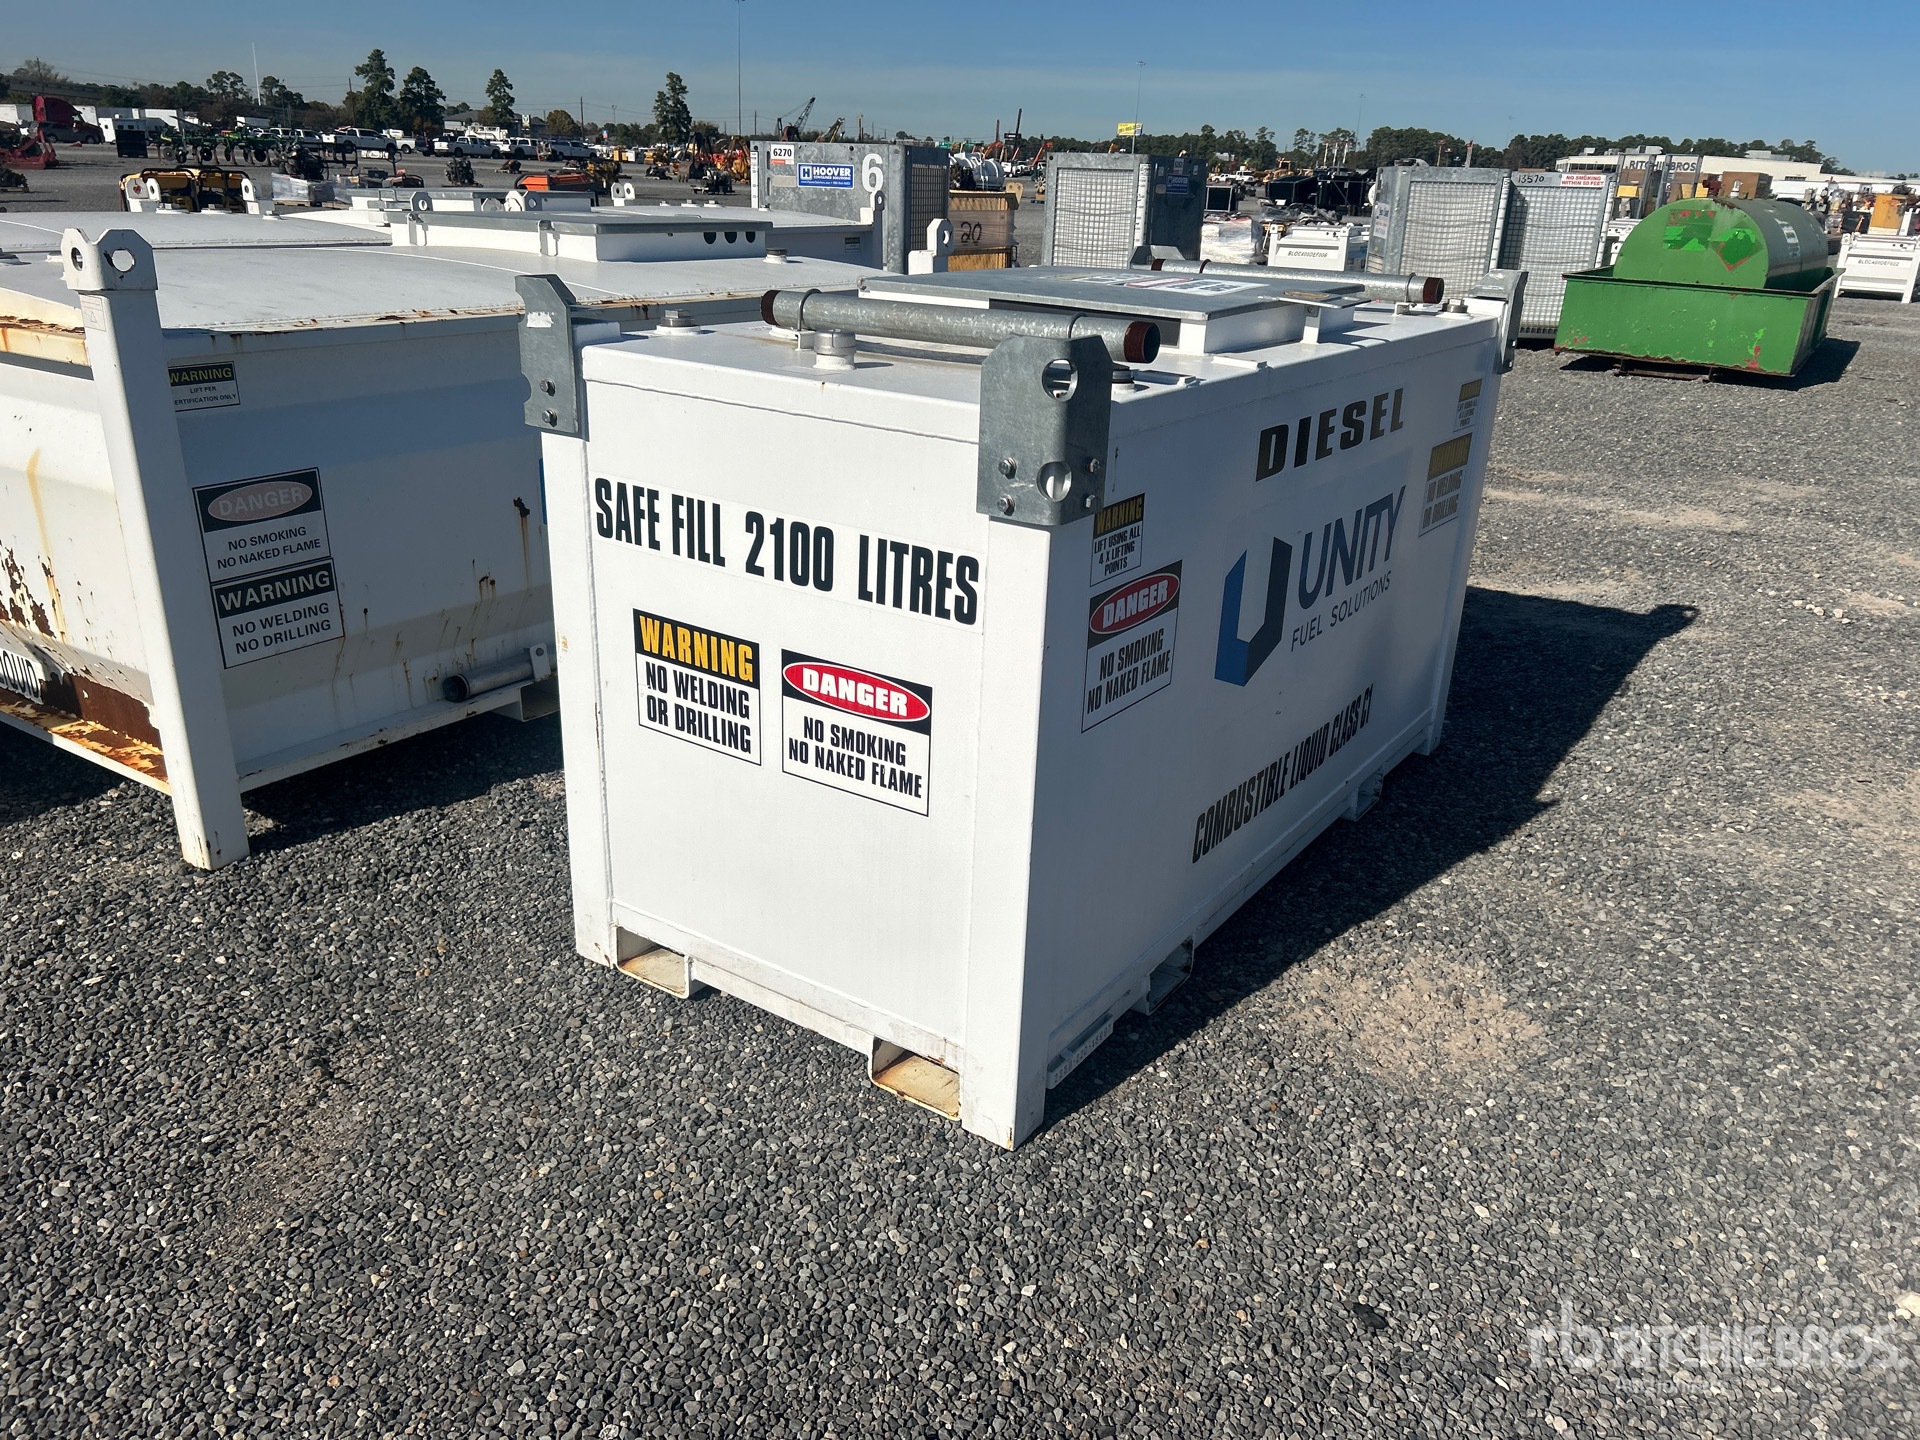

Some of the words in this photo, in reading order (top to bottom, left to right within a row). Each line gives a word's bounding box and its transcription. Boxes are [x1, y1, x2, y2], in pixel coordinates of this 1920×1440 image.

[773, 148, 792, 157] 6270
[812, 166, 851, 176] HOOVER
[862, 153, 884, 192] 6
[174, 396, 219, 406] ERTIFICATION
[219, 393, 237, 401] ONLY
[204, 385, 217, 393] PER
[1255, 387, 1404, 482] DIESEL
[218, 486, 304, 517] DANGER
[1096, 498, 1143, 534] WARNING
[217, 556, 237, 570] NO
[238, 549, 281, 566] NAKED
[282, 538, 321, 556] FLAME
[228, 538, 248, 551] NO
[249, 526, 307, 547] SMOKING
[595, 477, 661, 551] SAFE
[671, 493, 726, 567] FILL
[745, 511, 834, 592] 2100
[858, 534, 980, 626] LITRES
[1093, 540, 1107, 554] LIFT
[1108, 529, 1128, 548] USING
[1129, 524, 1141, 538] ALL
[1111, 540, 1136, 560] LIFTING
[1299, 484, 1406, 610] UNITY
[220, 570, 331, 612] WARNING
[1104, 560, 1128, 577] POINTS
[232, 621, 256, 637] NO
[259, 602, 330, 629] WELDING
[1102, 579, 1169, 629] DANGER
[1291, 614, 1323, 653] FUEL
[1330, 570, 1392, 628] SOLUTIONS
[235, 638, 260, 655] NO
[262, 619, 332, 649] DRILLING
[639, 615, 754, 683] WARNING
[1100, 656, 1115, 682] NO
[1117, 628, 1165, 672] SMOKING
[0, 648, 41, 699] IQUID
[645, 661, 668, 694] NO
[673, 669, 750, 720] WELDING
[802, 667, 908, 717] DANGER
[1087, 685, 1103, 715] NO
[1105, 664, 1138, 705] NAKED
[1140, 649, 1171, 687] FLAME
[646, 694, 669, 727] OR
[674, 703, 752, 754] DRILLING
[803, 715, 825, 743] NO
[830, 723, 906, 767] SMOKING
[788, 737, 809, 765] NO
[814, 745, 865, 782] NAKED
[871, 761, 922, 799] FLAME
[1192, 751, 1291, 864] COMBUSTIBLE
[1288, 721, 1330, 790] LIQUID
[1328, 694, 1362, 758] CLASS
